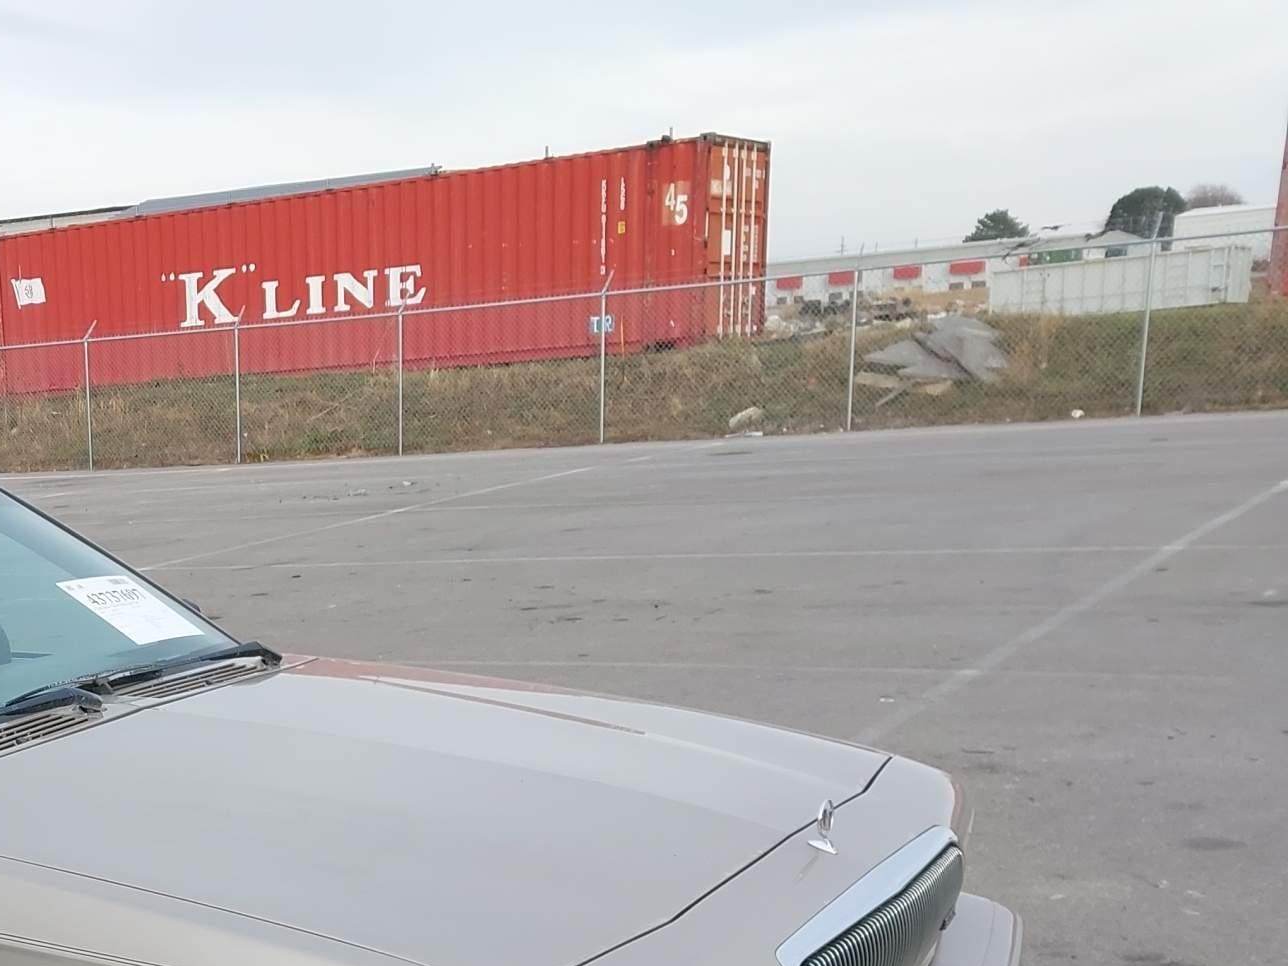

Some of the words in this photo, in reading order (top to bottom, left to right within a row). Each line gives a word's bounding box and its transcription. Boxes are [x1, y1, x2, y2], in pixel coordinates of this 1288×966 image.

[664, 183, 688, 225] 45
[261, 264, 427, 320] LINE
[590, 314, 615, 333] TR
